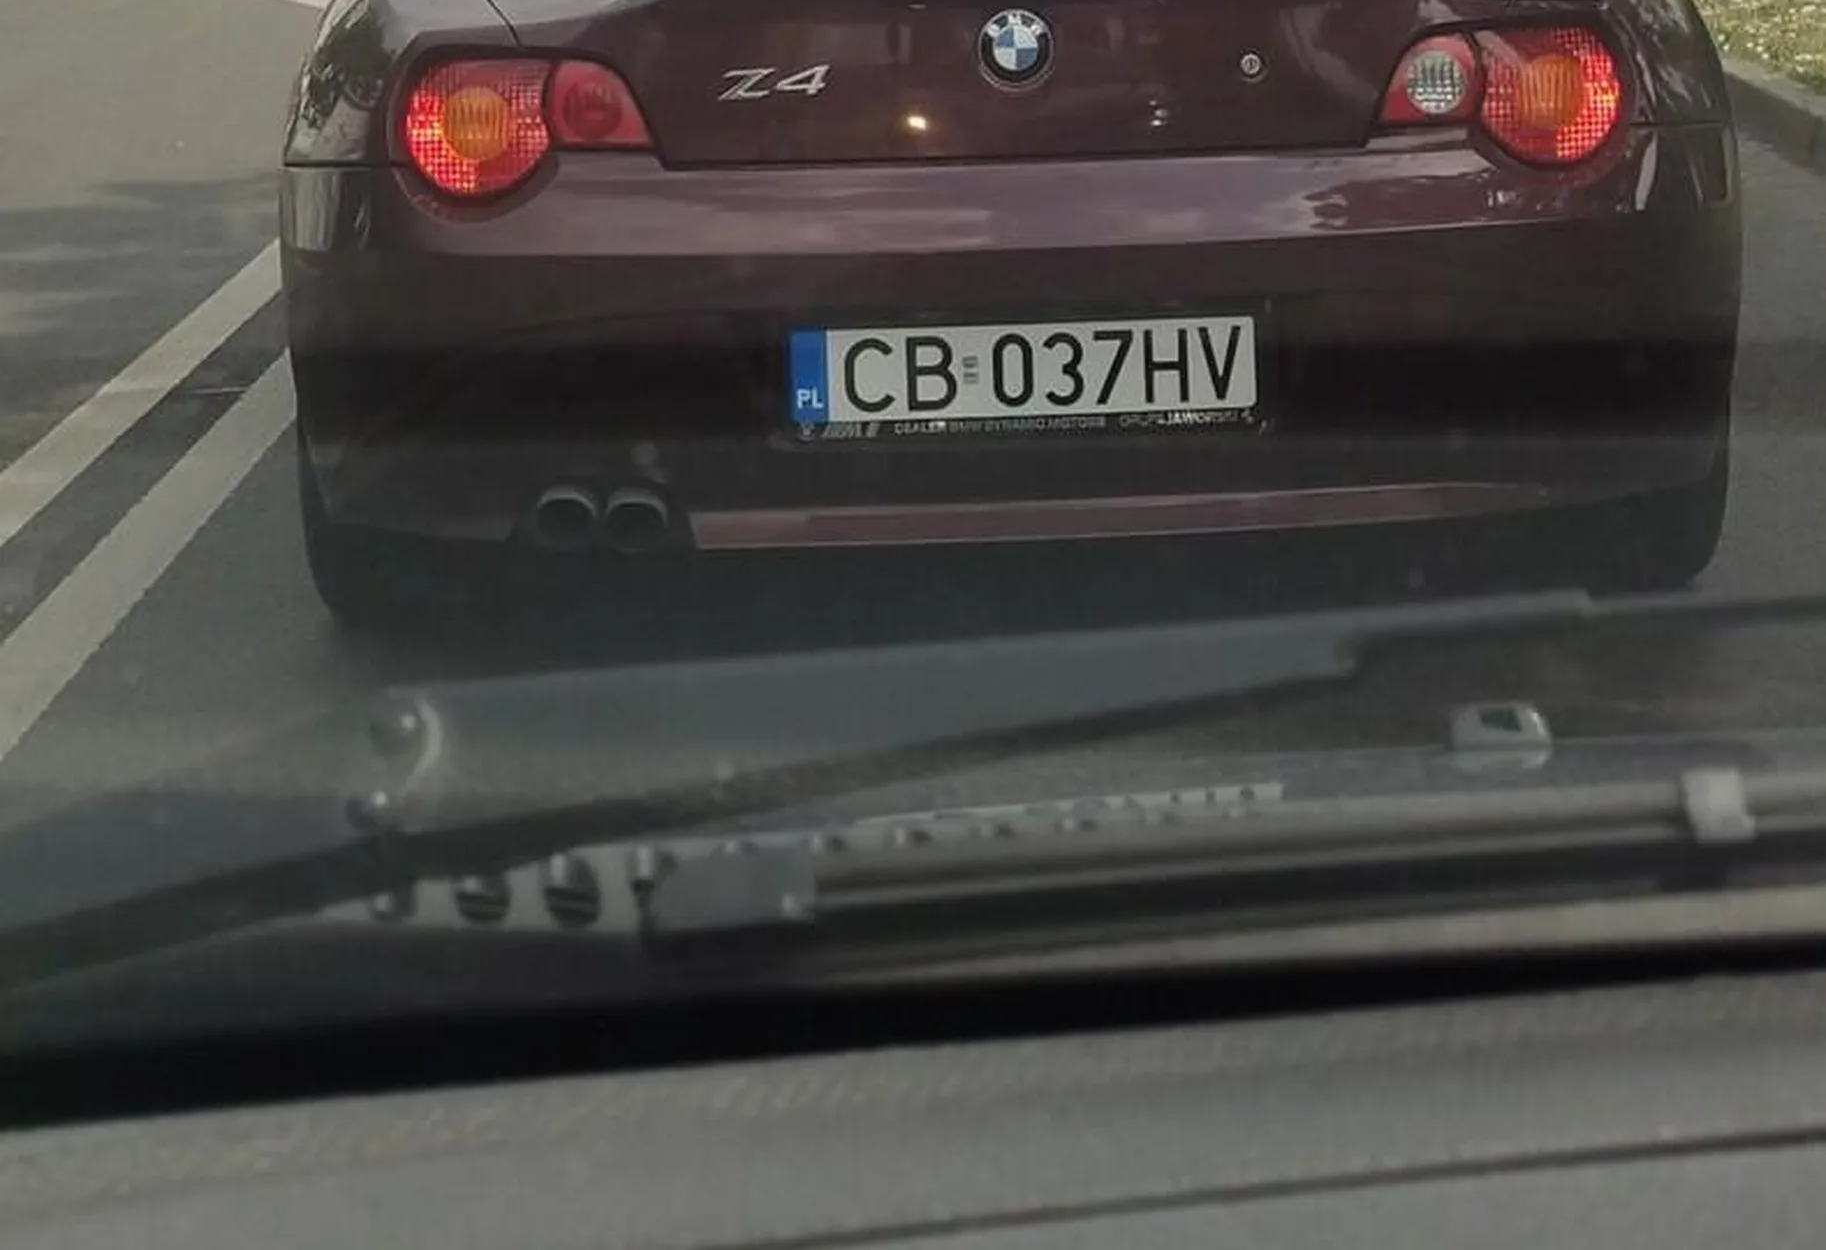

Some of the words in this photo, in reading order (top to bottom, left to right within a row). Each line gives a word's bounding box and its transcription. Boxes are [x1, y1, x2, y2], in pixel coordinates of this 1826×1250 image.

[717, 64, 830, 101] Z4
[843, 335, 959, 413] CB
[991, 324, 1242, 408] 037HV
[796, 388, 825, 409] PL
